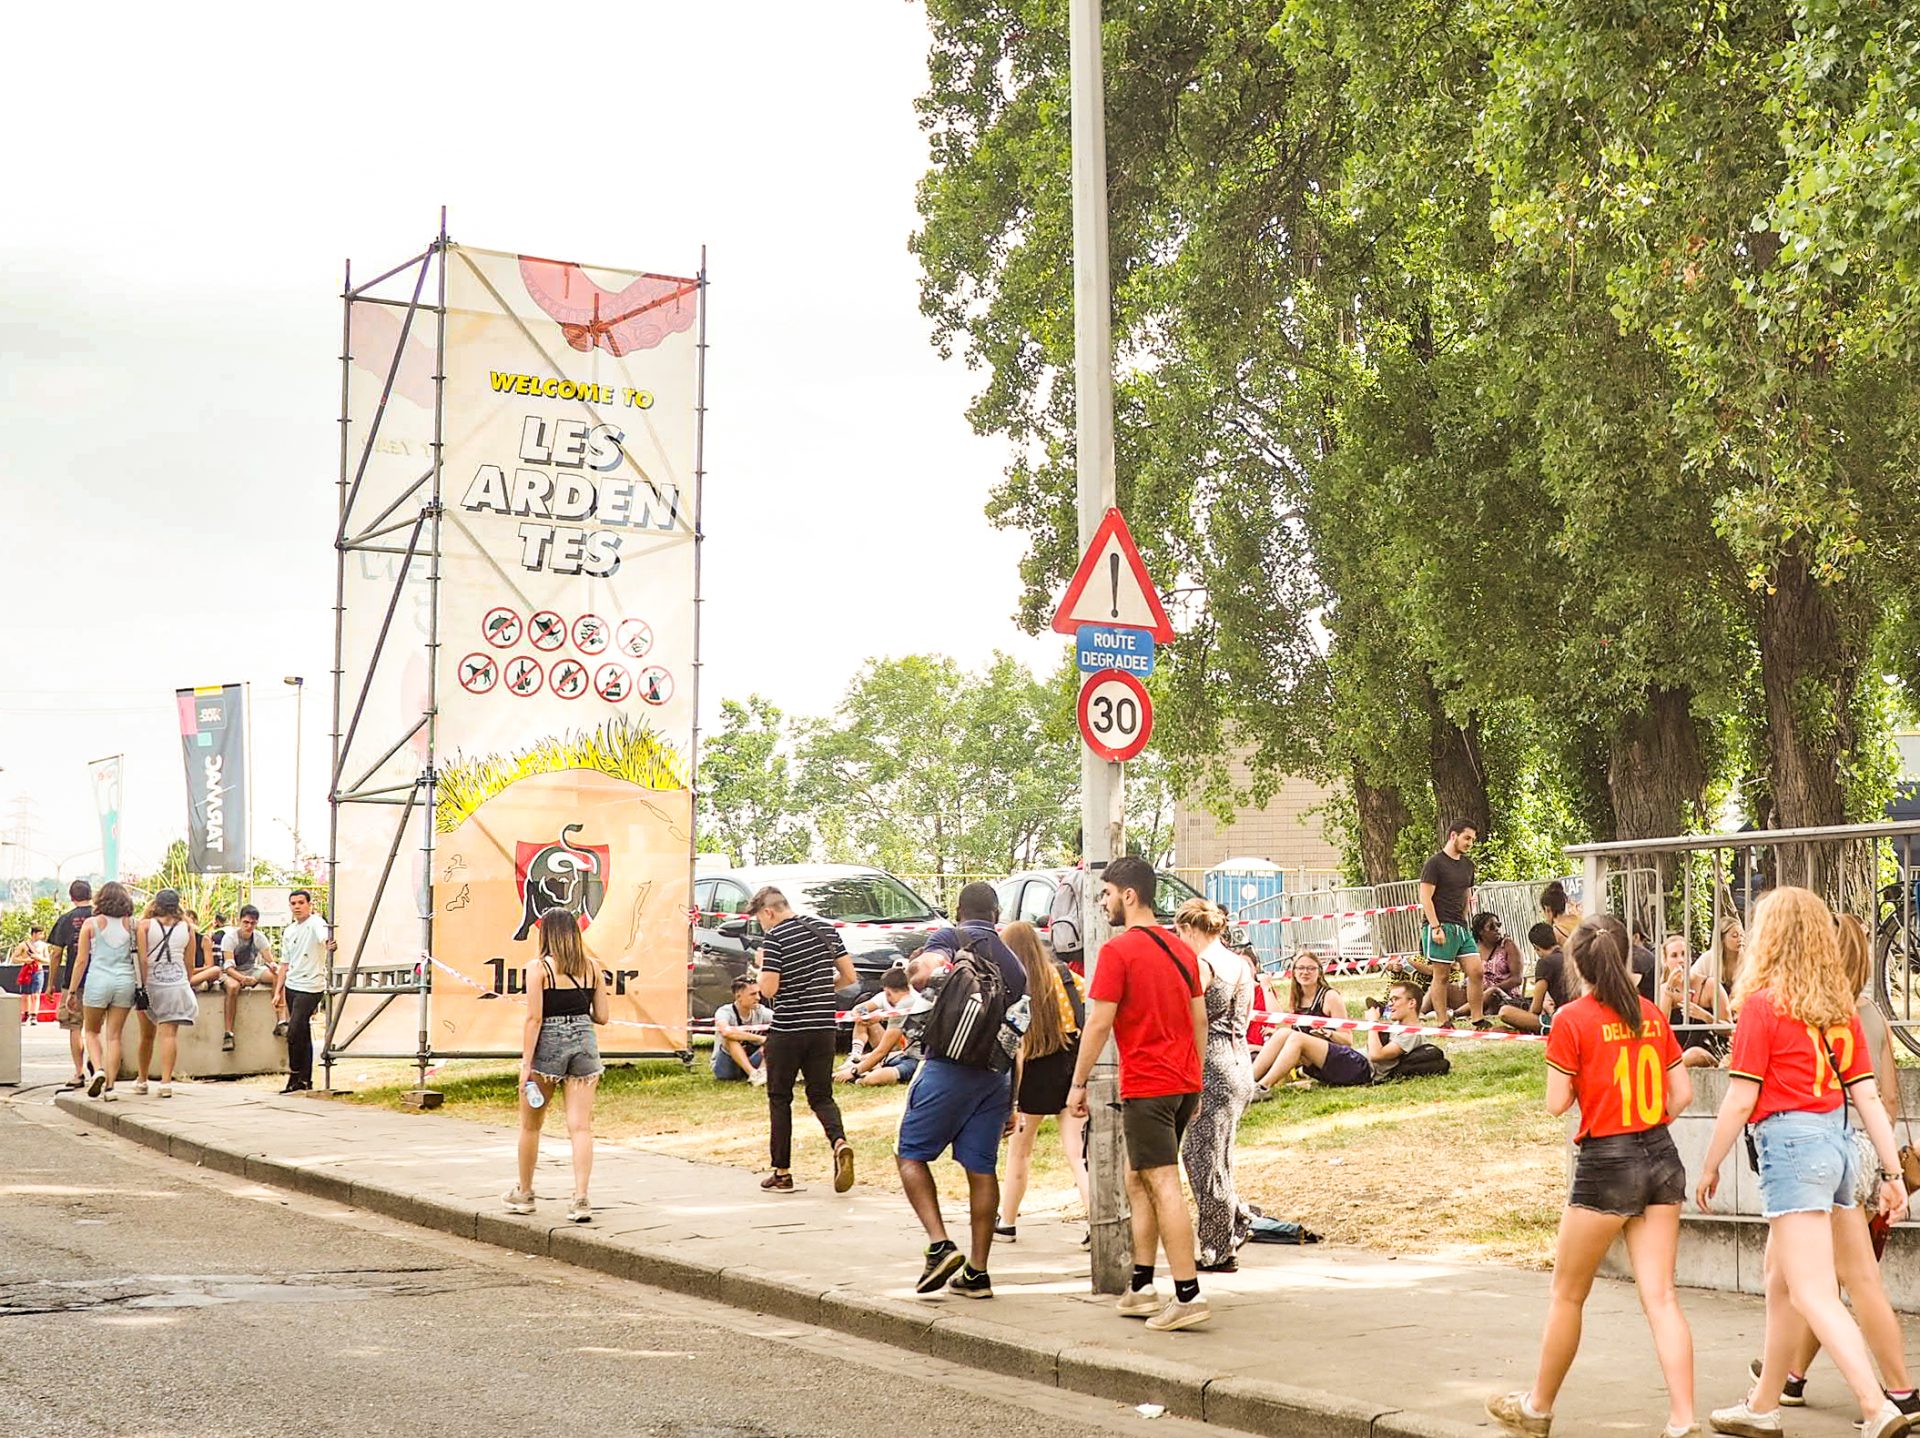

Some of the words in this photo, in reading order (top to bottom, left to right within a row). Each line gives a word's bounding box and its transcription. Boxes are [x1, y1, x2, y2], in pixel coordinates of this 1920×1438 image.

[490, 371, 614, 405] WELCOME
[622, 387, 655, 409] TO
[518, 415, 625, 472] LES
[460, 464, 679, 530] ARDEN
[518, 522, 623, 578] TES
[1081, 651, 1149, 671] DEGRADEE
[1093, 632, 1137, 651] ROUTE
[1092, 696, 1137, 735] 30
[1614, 1043, 1663, 1127] 10
